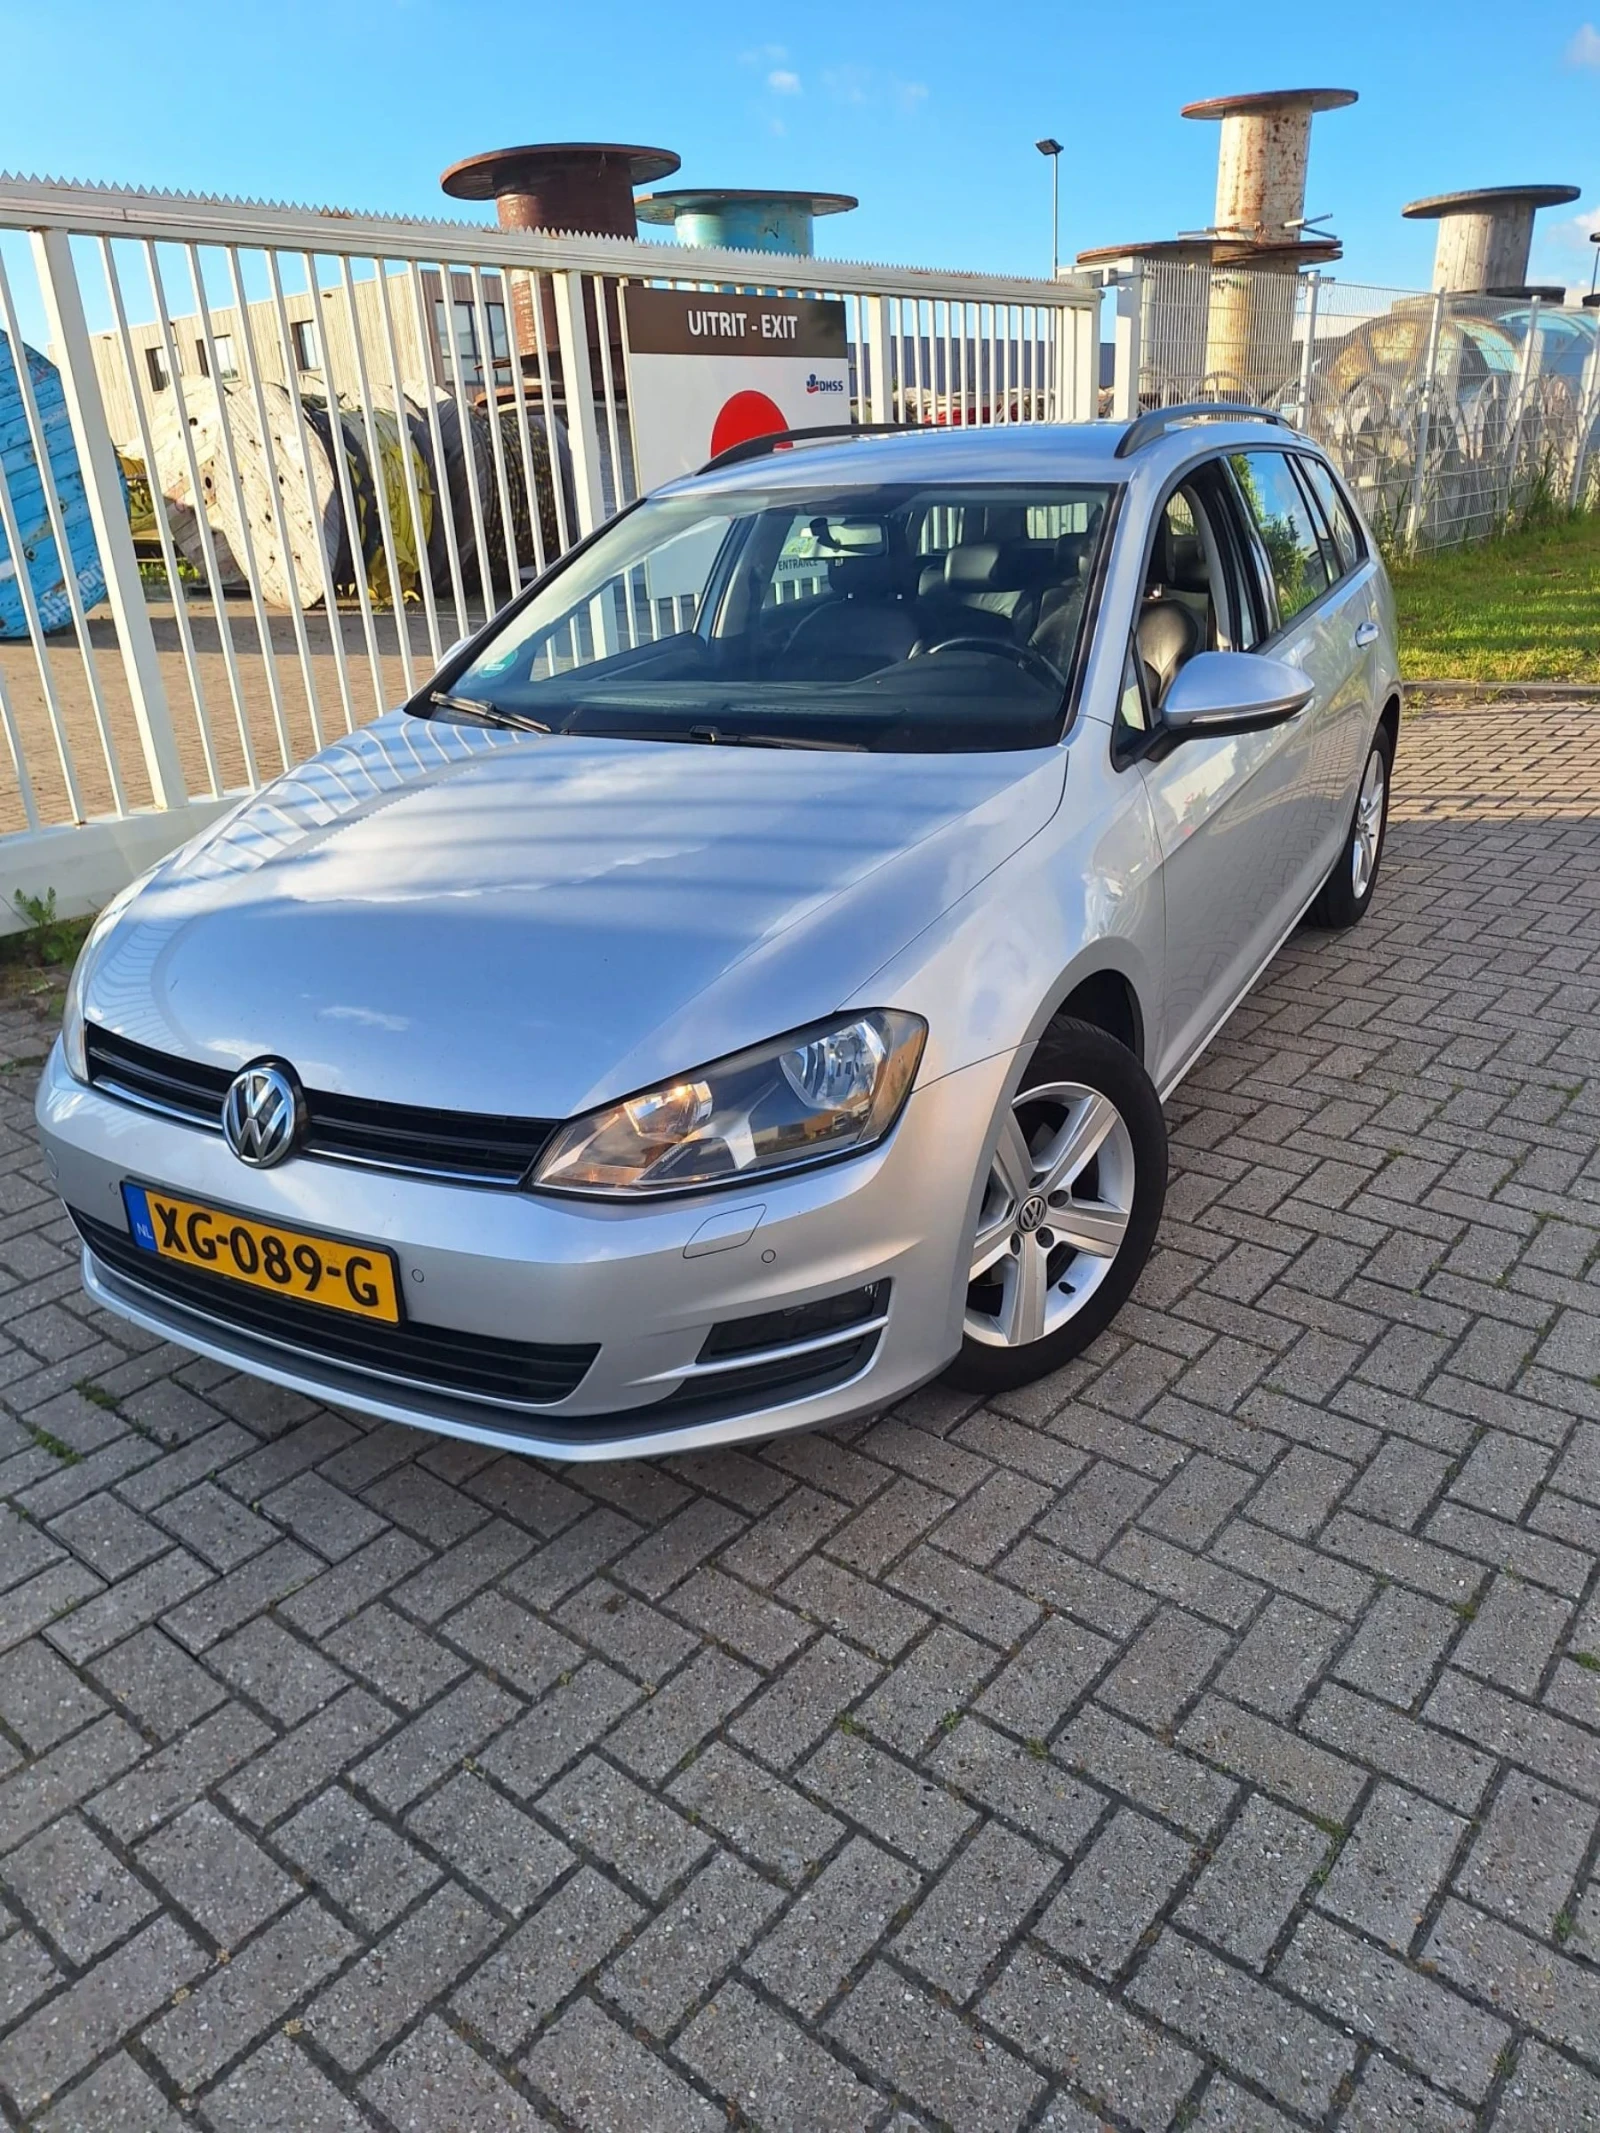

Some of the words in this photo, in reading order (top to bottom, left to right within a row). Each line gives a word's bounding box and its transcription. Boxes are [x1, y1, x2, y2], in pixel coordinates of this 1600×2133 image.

[687, 310, 747, 338] UITRIT
[761, 314, 798, 339] EXIT
[820, 380, 844, 392] DHSS
[136, 1221, 154, 1240] NL
[154, 1202, 380, 1307] XG-089-G
